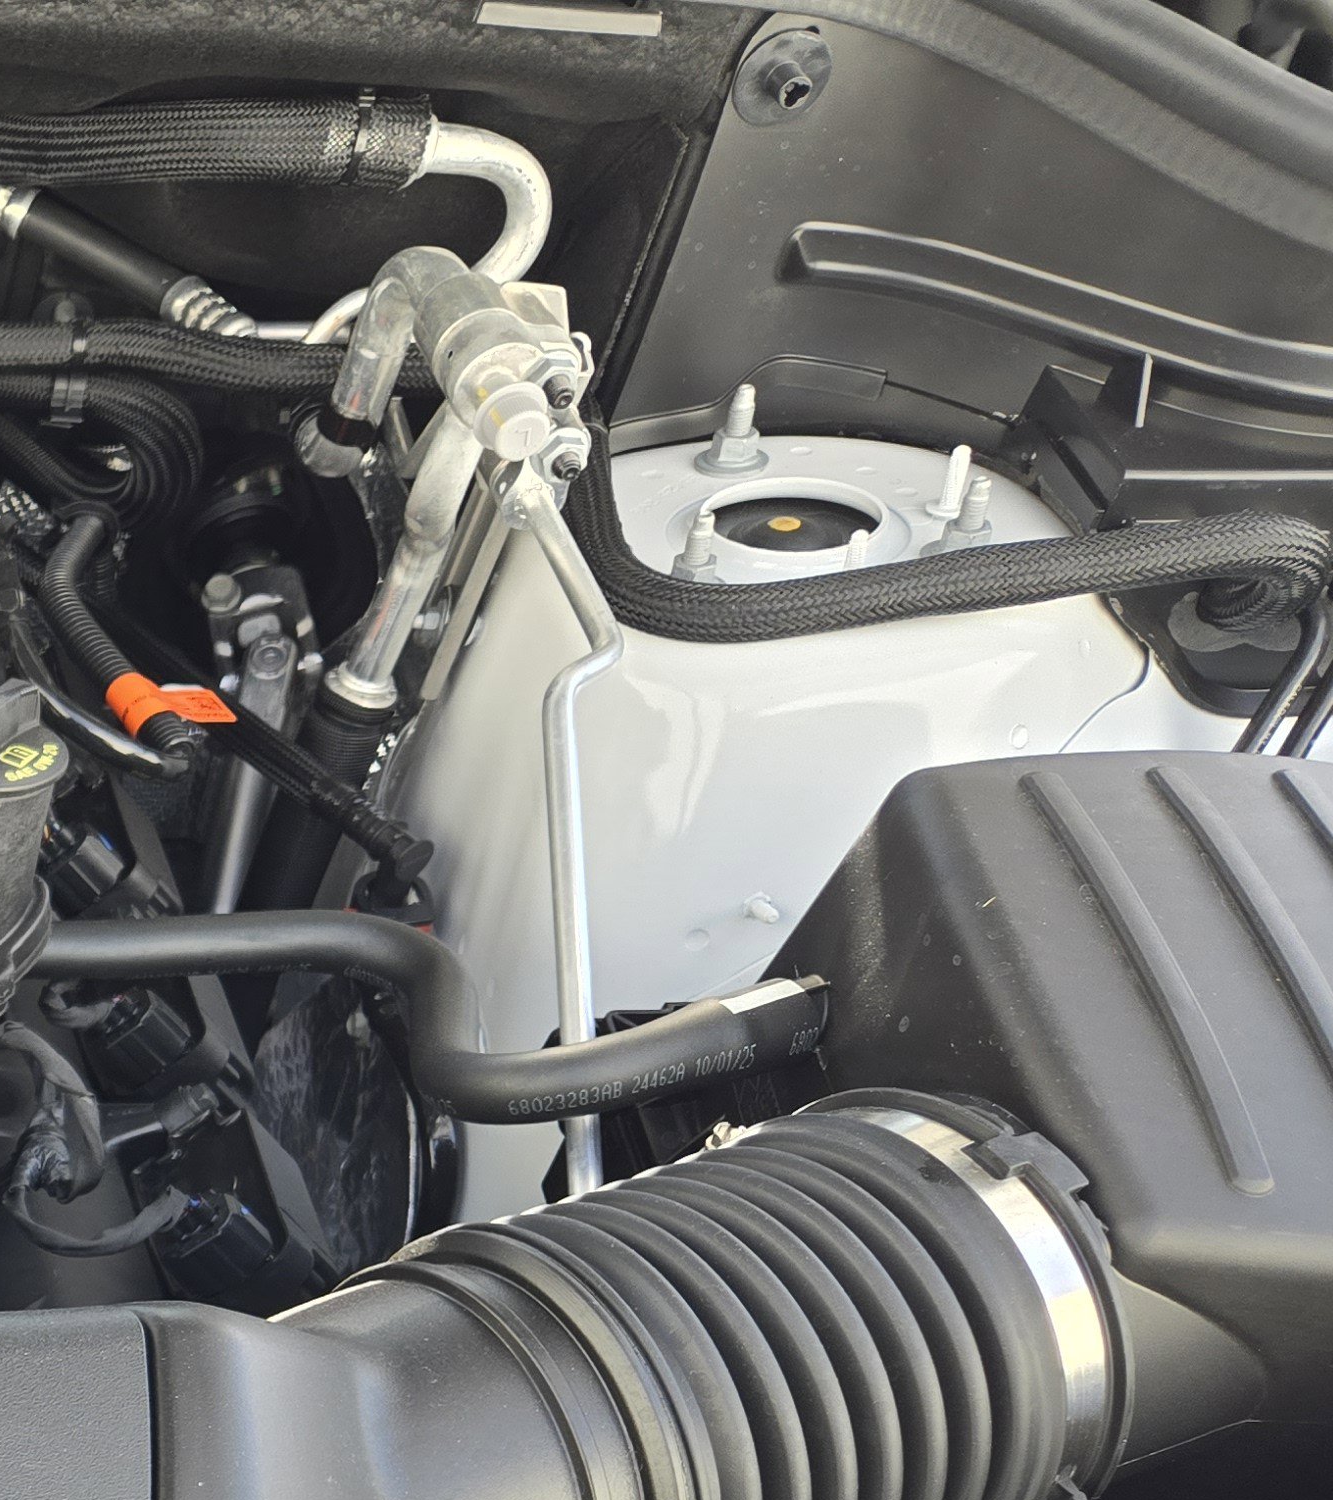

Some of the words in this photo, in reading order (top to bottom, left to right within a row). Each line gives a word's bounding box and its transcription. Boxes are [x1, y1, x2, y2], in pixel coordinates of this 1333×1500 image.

[507, 1081, 623, 1116] 68023283AB
[632, 1063, 686, 1095] 24462A
[695, 1043, 757, 1078] 10/01/25
